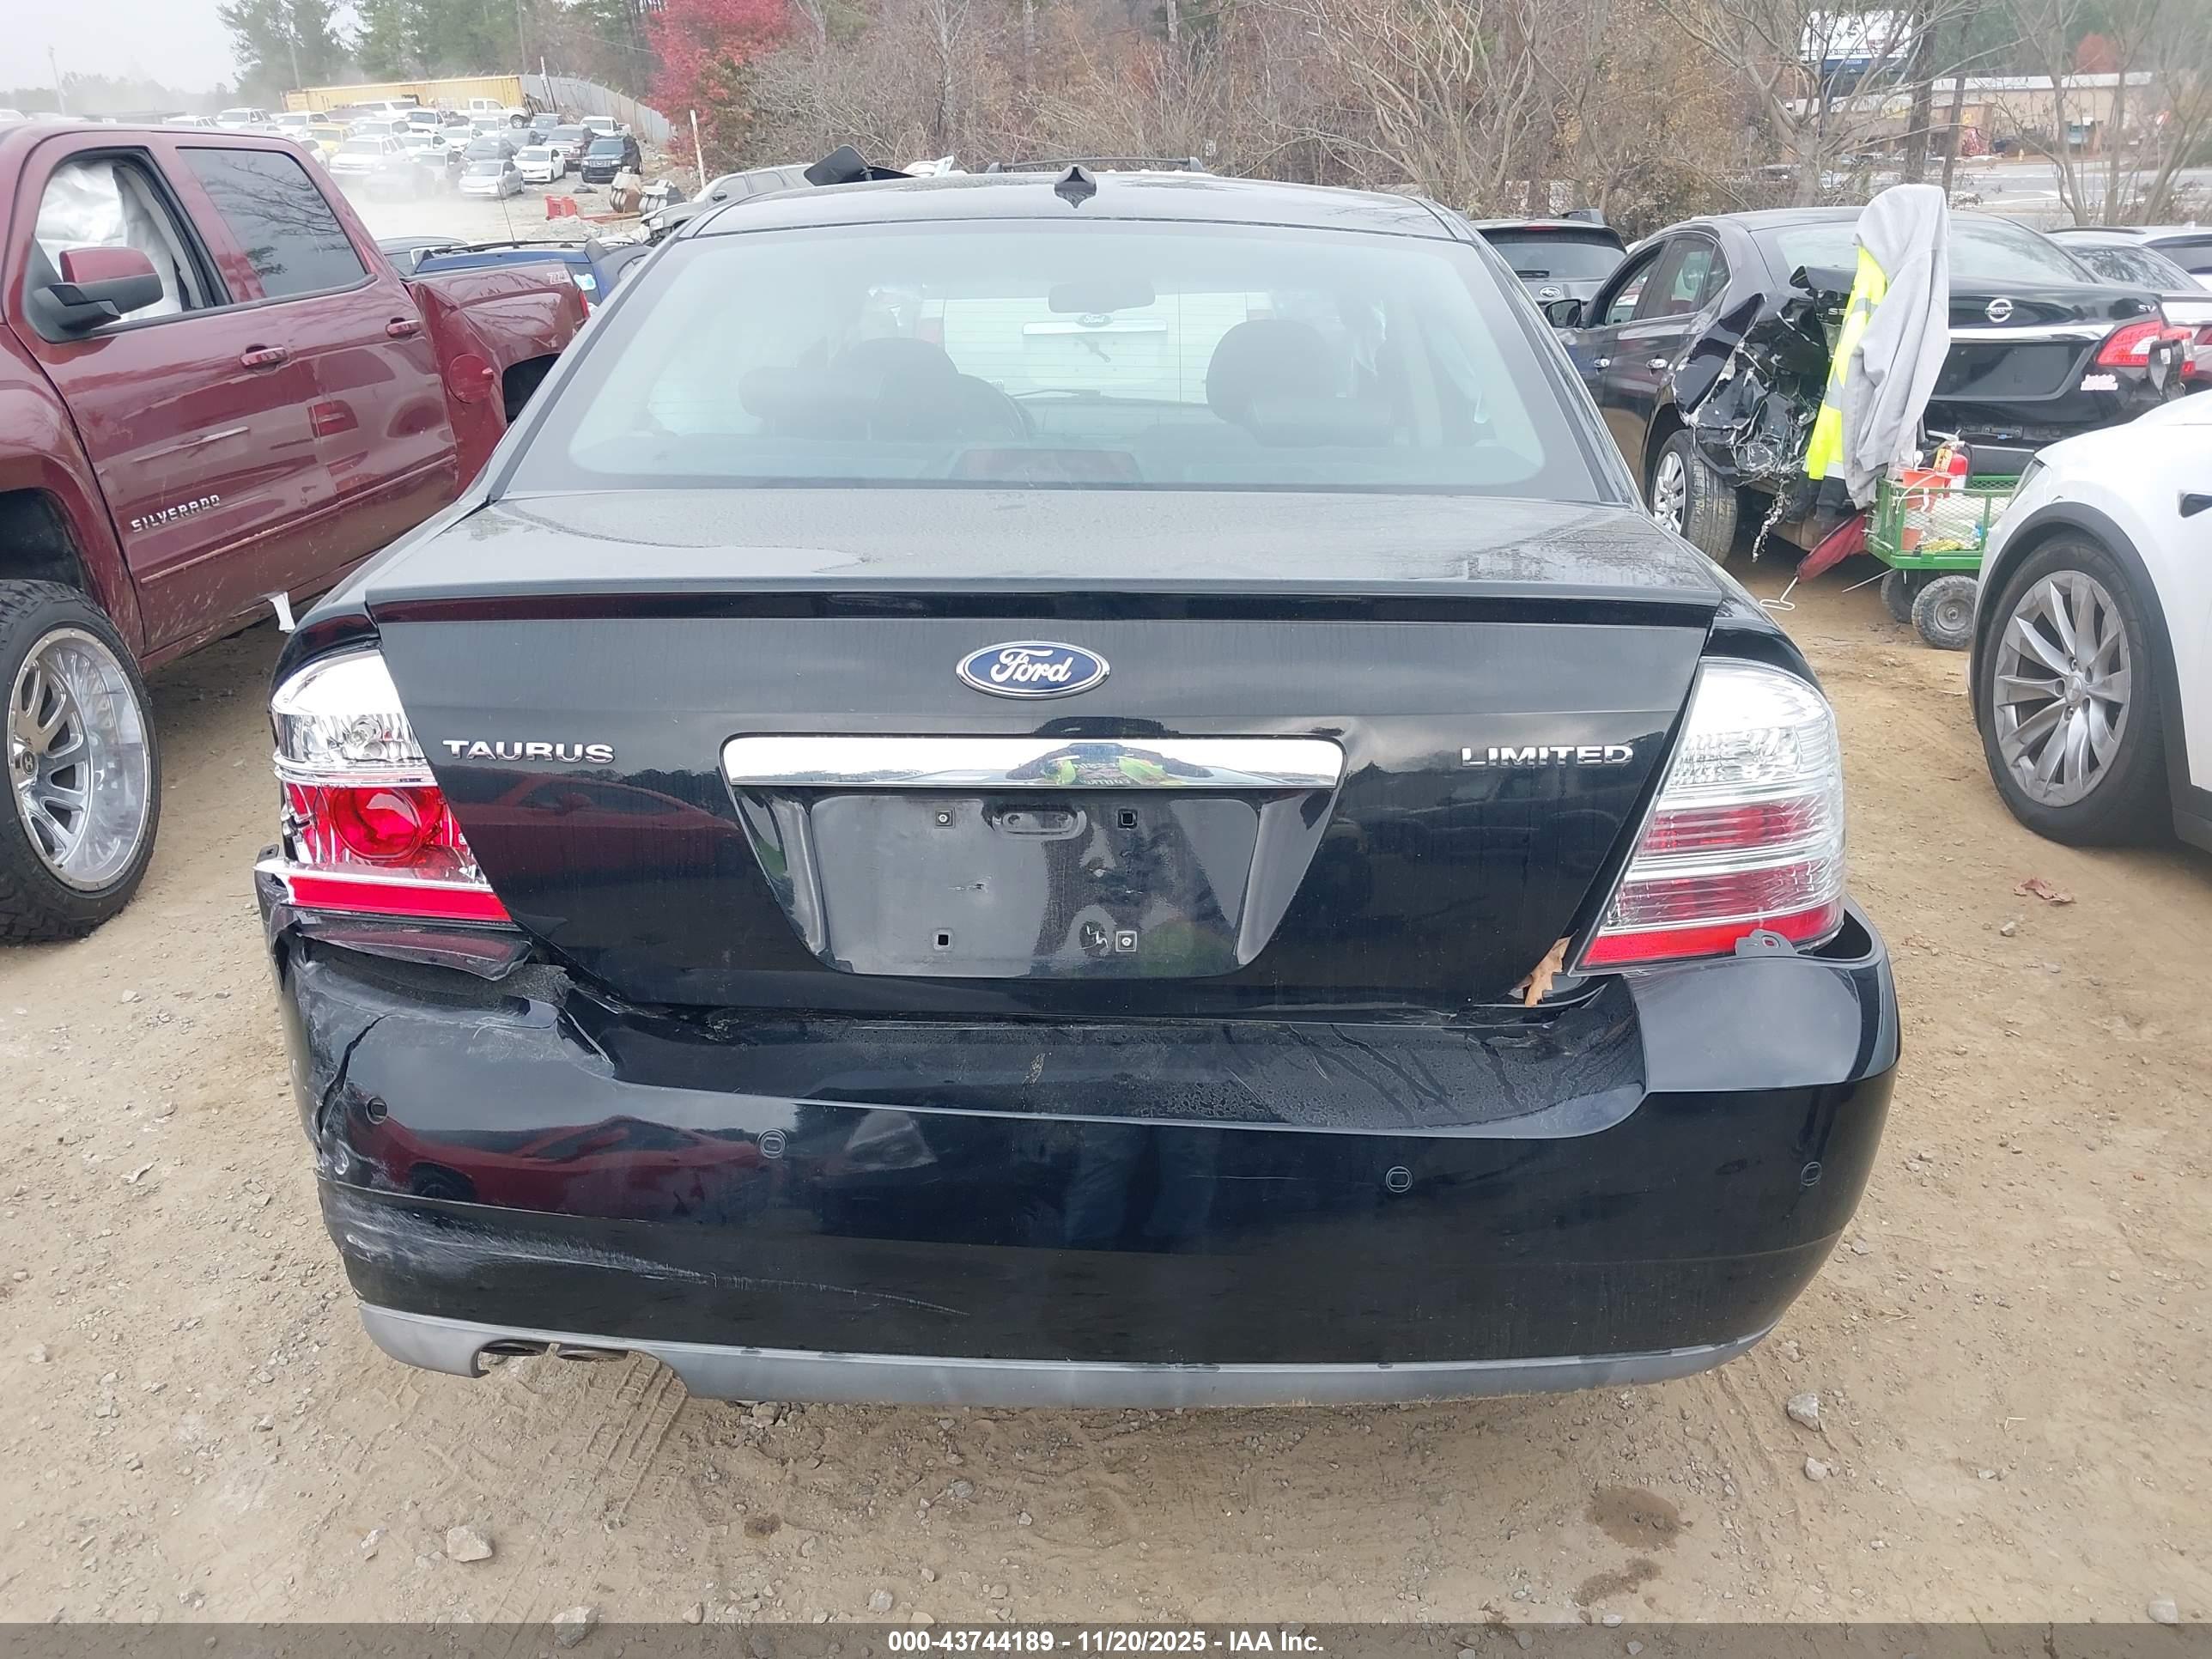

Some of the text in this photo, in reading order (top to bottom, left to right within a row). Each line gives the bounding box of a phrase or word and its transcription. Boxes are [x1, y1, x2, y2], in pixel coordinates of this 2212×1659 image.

[2138, 304, 2156, 313] SV
[131, 494, 221, 533] SILVERADO
[990, 647, 1073, 683] Ford
[442, 739, 614, 764] TAURUS
[1462, 745, 1633, 767] LIMITED
